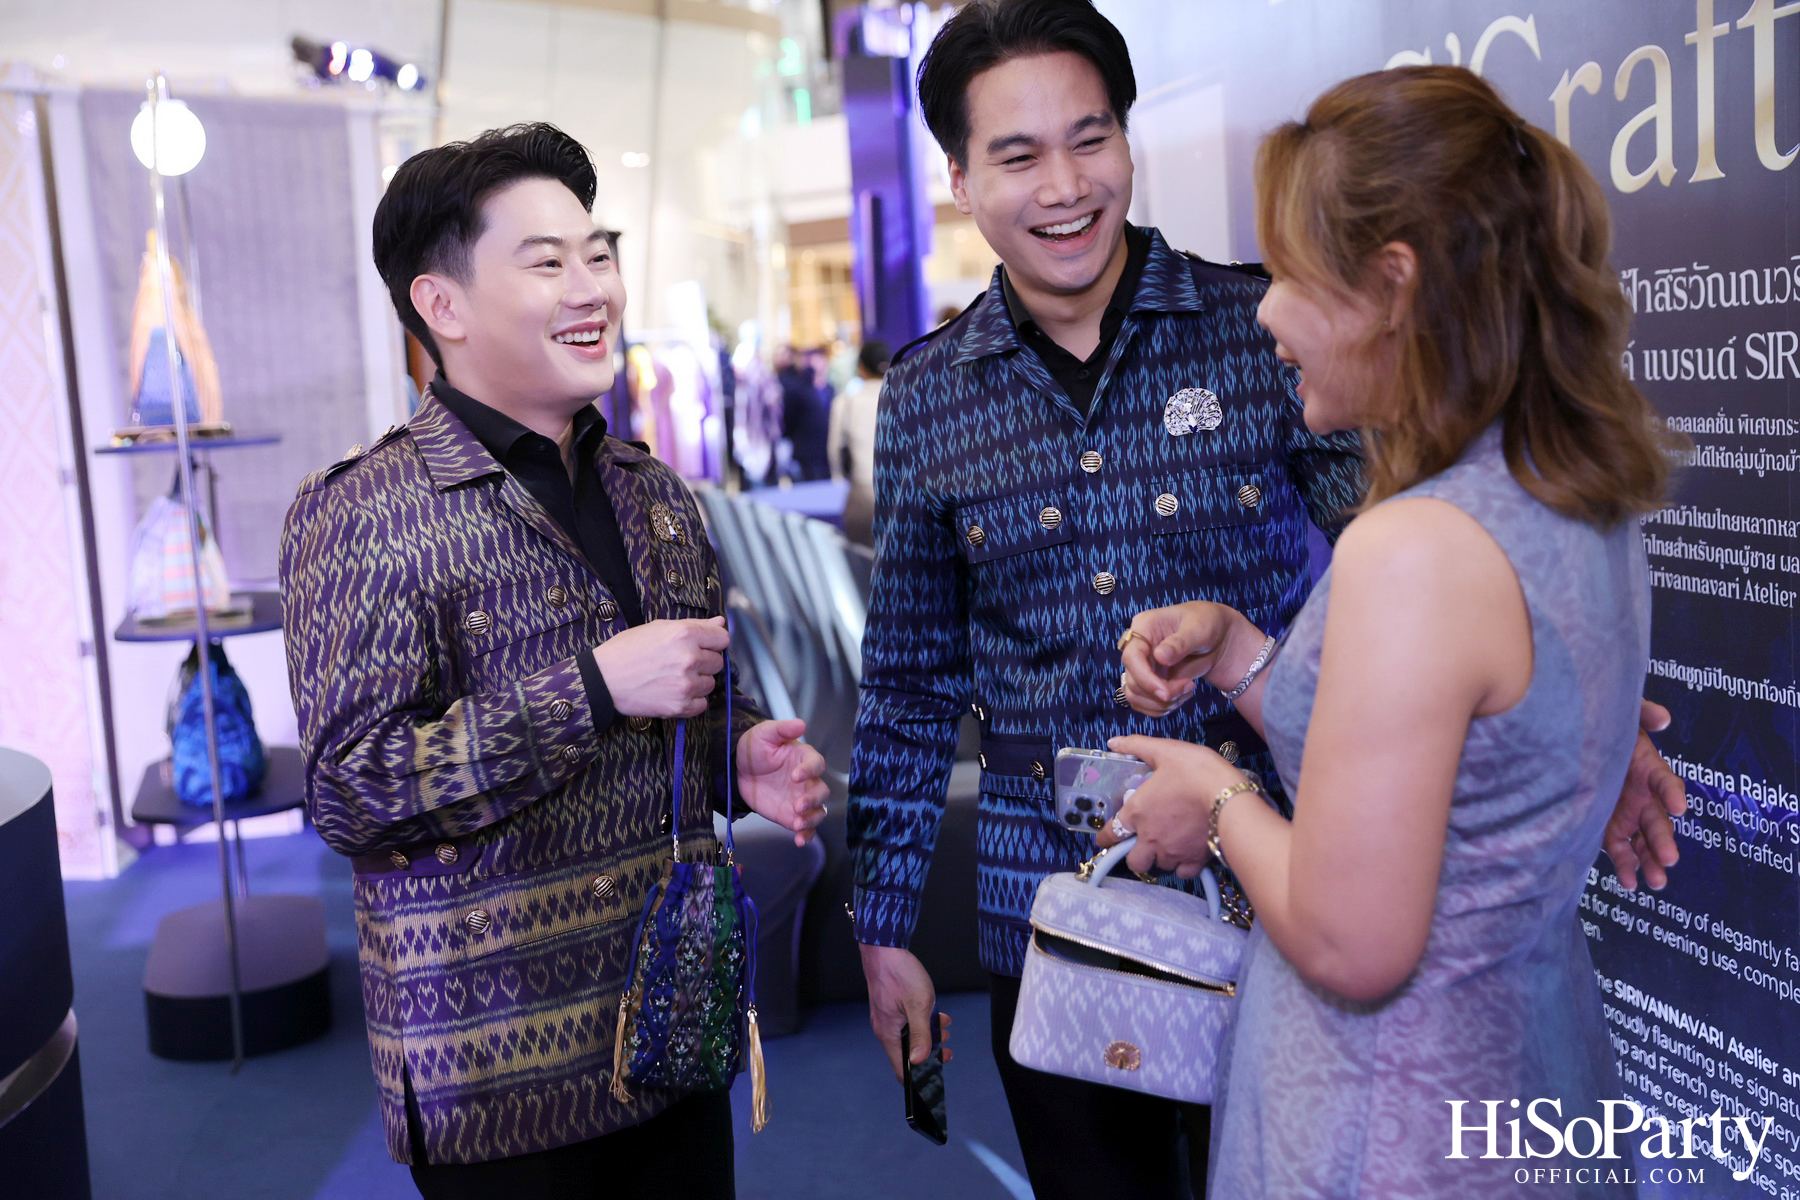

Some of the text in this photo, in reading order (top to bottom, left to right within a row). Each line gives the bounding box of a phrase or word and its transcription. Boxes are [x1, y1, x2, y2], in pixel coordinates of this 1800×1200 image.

[1642, 336, 1738, 381] แบรนด์
[1647, 564, 1797, 609] irivannavari Atelier
[1659, 749, 1735, 793] ariratana
[1706, 800, 1783, 843] collection,
[1724, 830, 1737, 853] is
[1739, 841, 1794, 874] crafted
[1592, 893, 1610, 917] for
[1610, 905, 1636, 933] day
[1636, 918, 1651, 936] or
[1652, 924, 1709, 966] evening
[1711, 950, 1741, 980] use,
[1637, 891, 1656, 911] an
[1657, 899, 1692, 929] array
[1694, 913, 1710, 933] of
[1711, 920, 1782, 968] elegantly
[1603, 1003, 1650, 1043] proudly
[1652, 1024, 1715, 1078] flaunting
[1718, 1060, 1744, 1089] the
[1614, 979, 1724, 1050] SIRIVANNAVARI
[1727, 1036, 1780, 1077] Atelier
[1624, 1062, 1638, 1087] in
[1639, 1073, 1663, 1100] the
[1664, 1091, 1714, 1128] creatio
[1630, 1044, 1657, 1071] and
[1659, 1056, 1708, 1099] French
